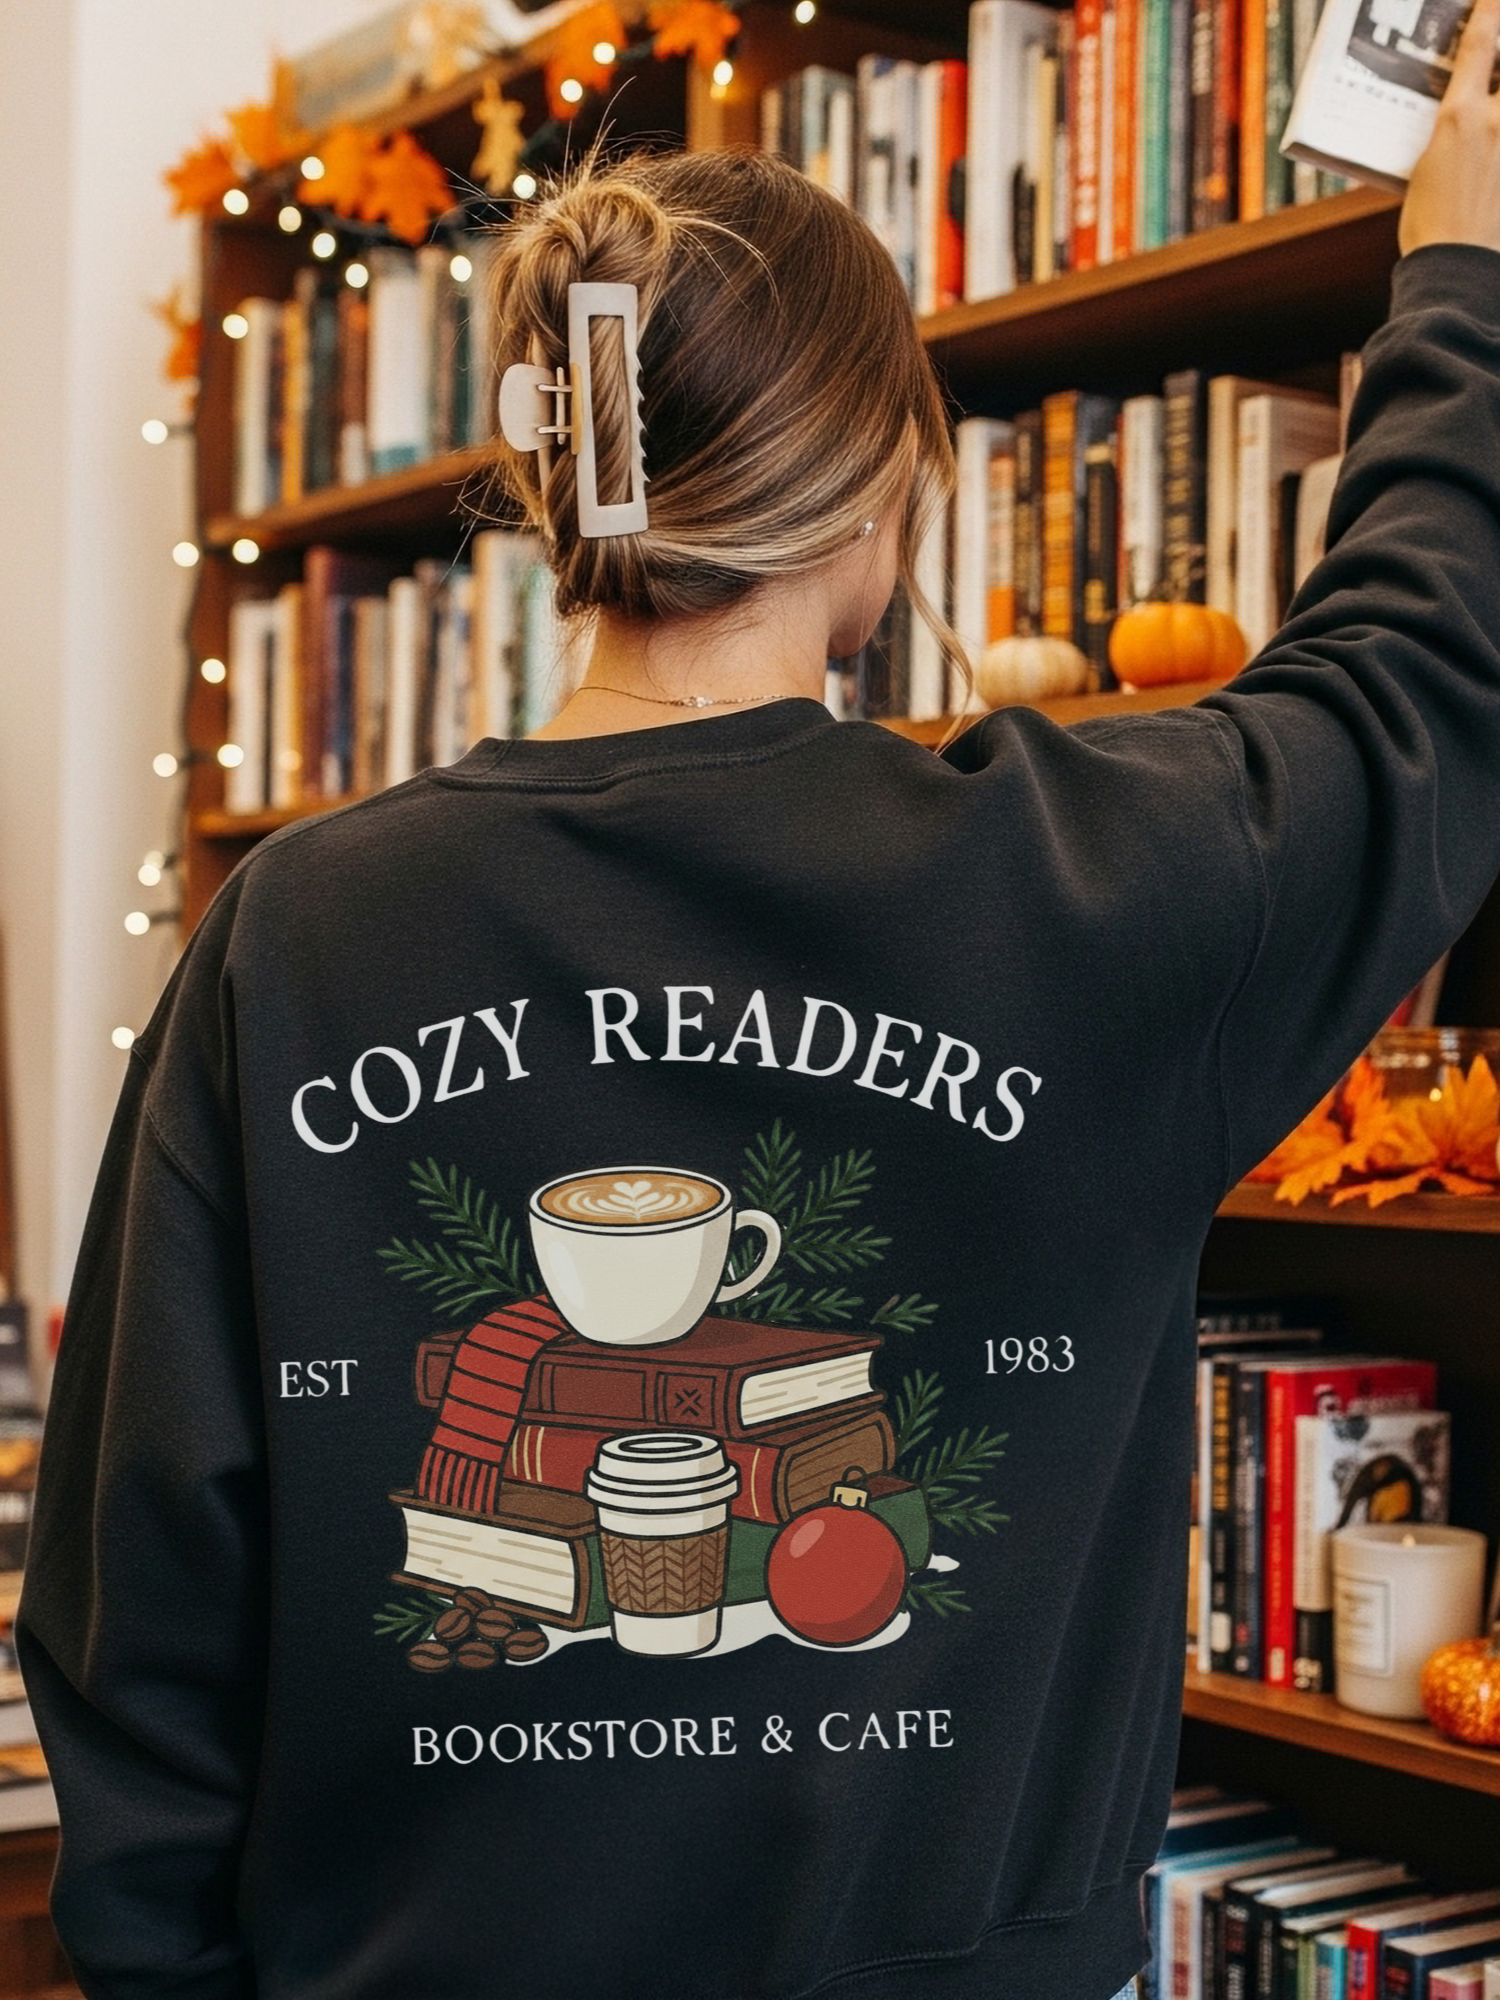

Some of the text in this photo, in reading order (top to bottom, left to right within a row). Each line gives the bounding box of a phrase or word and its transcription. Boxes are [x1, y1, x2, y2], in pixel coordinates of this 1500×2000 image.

[292, 986, 1042, 1153] COZY READERS
[986, 1336, 1074, 1373] 1983
[281, 1360, 357, 1397] EST
[413, 1710, 953, 1764] BOOKSTORE & CAFE
